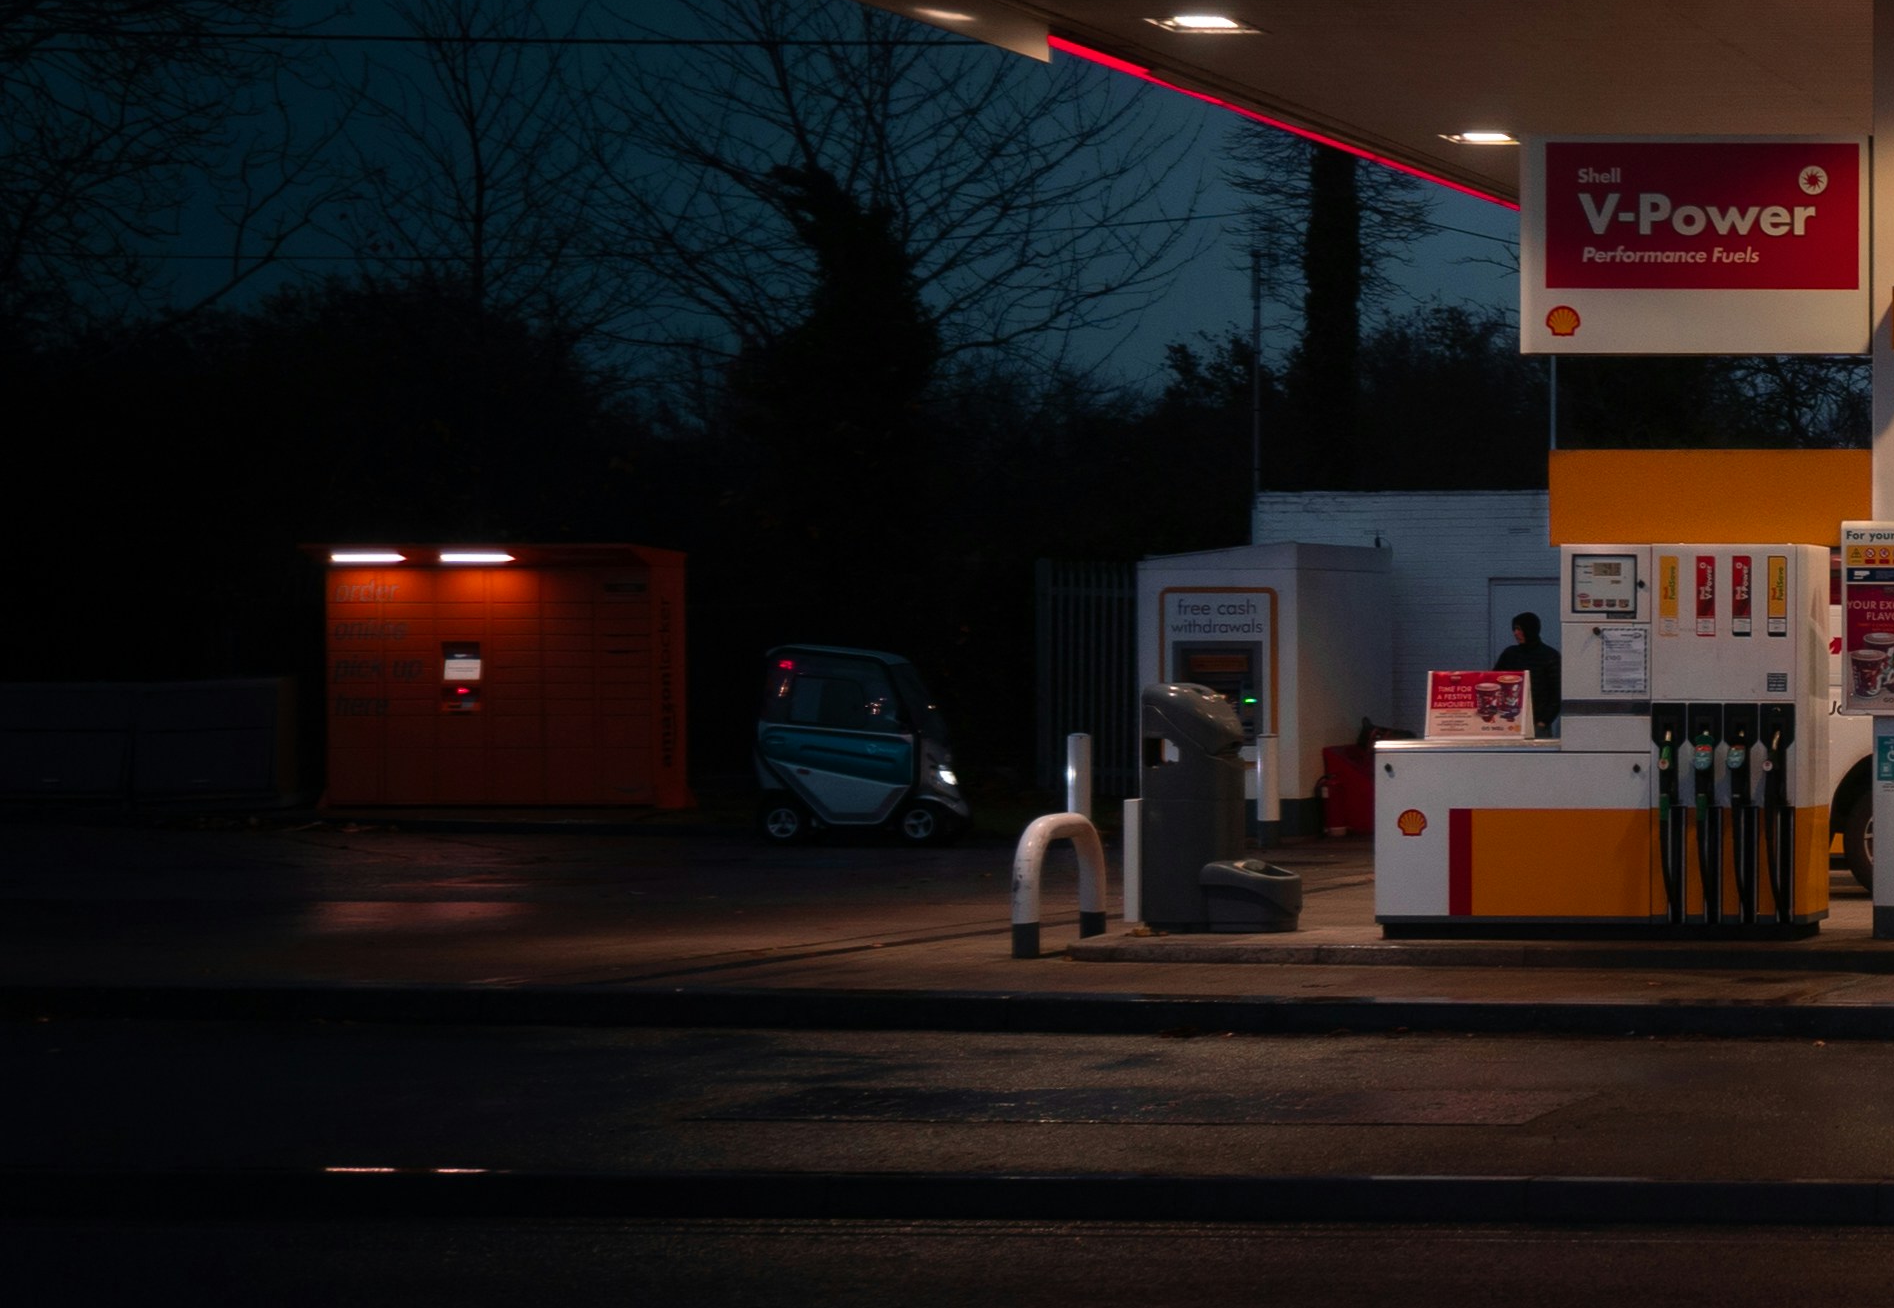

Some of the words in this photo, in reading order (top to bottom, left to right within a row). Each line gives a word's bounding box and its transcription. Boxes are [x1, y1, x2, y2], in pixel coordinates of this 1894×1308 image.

[1577, 168, 1621, 184] Shell
[1577, 193, 1816, 236] V-Power
[1582, 246, 1707, 264] Performance
[1712, 246, 1760, 264] Fuels
[1846, 530, 1865, 540] For
[335, 579, 400, 602] order
[1177, 599, 1211, 615] free
[1217, 600, 1256, 616] cash
[1847, 600, 1877, 610] YOUR
[1171, 619, 1263, 634] withdrawals
